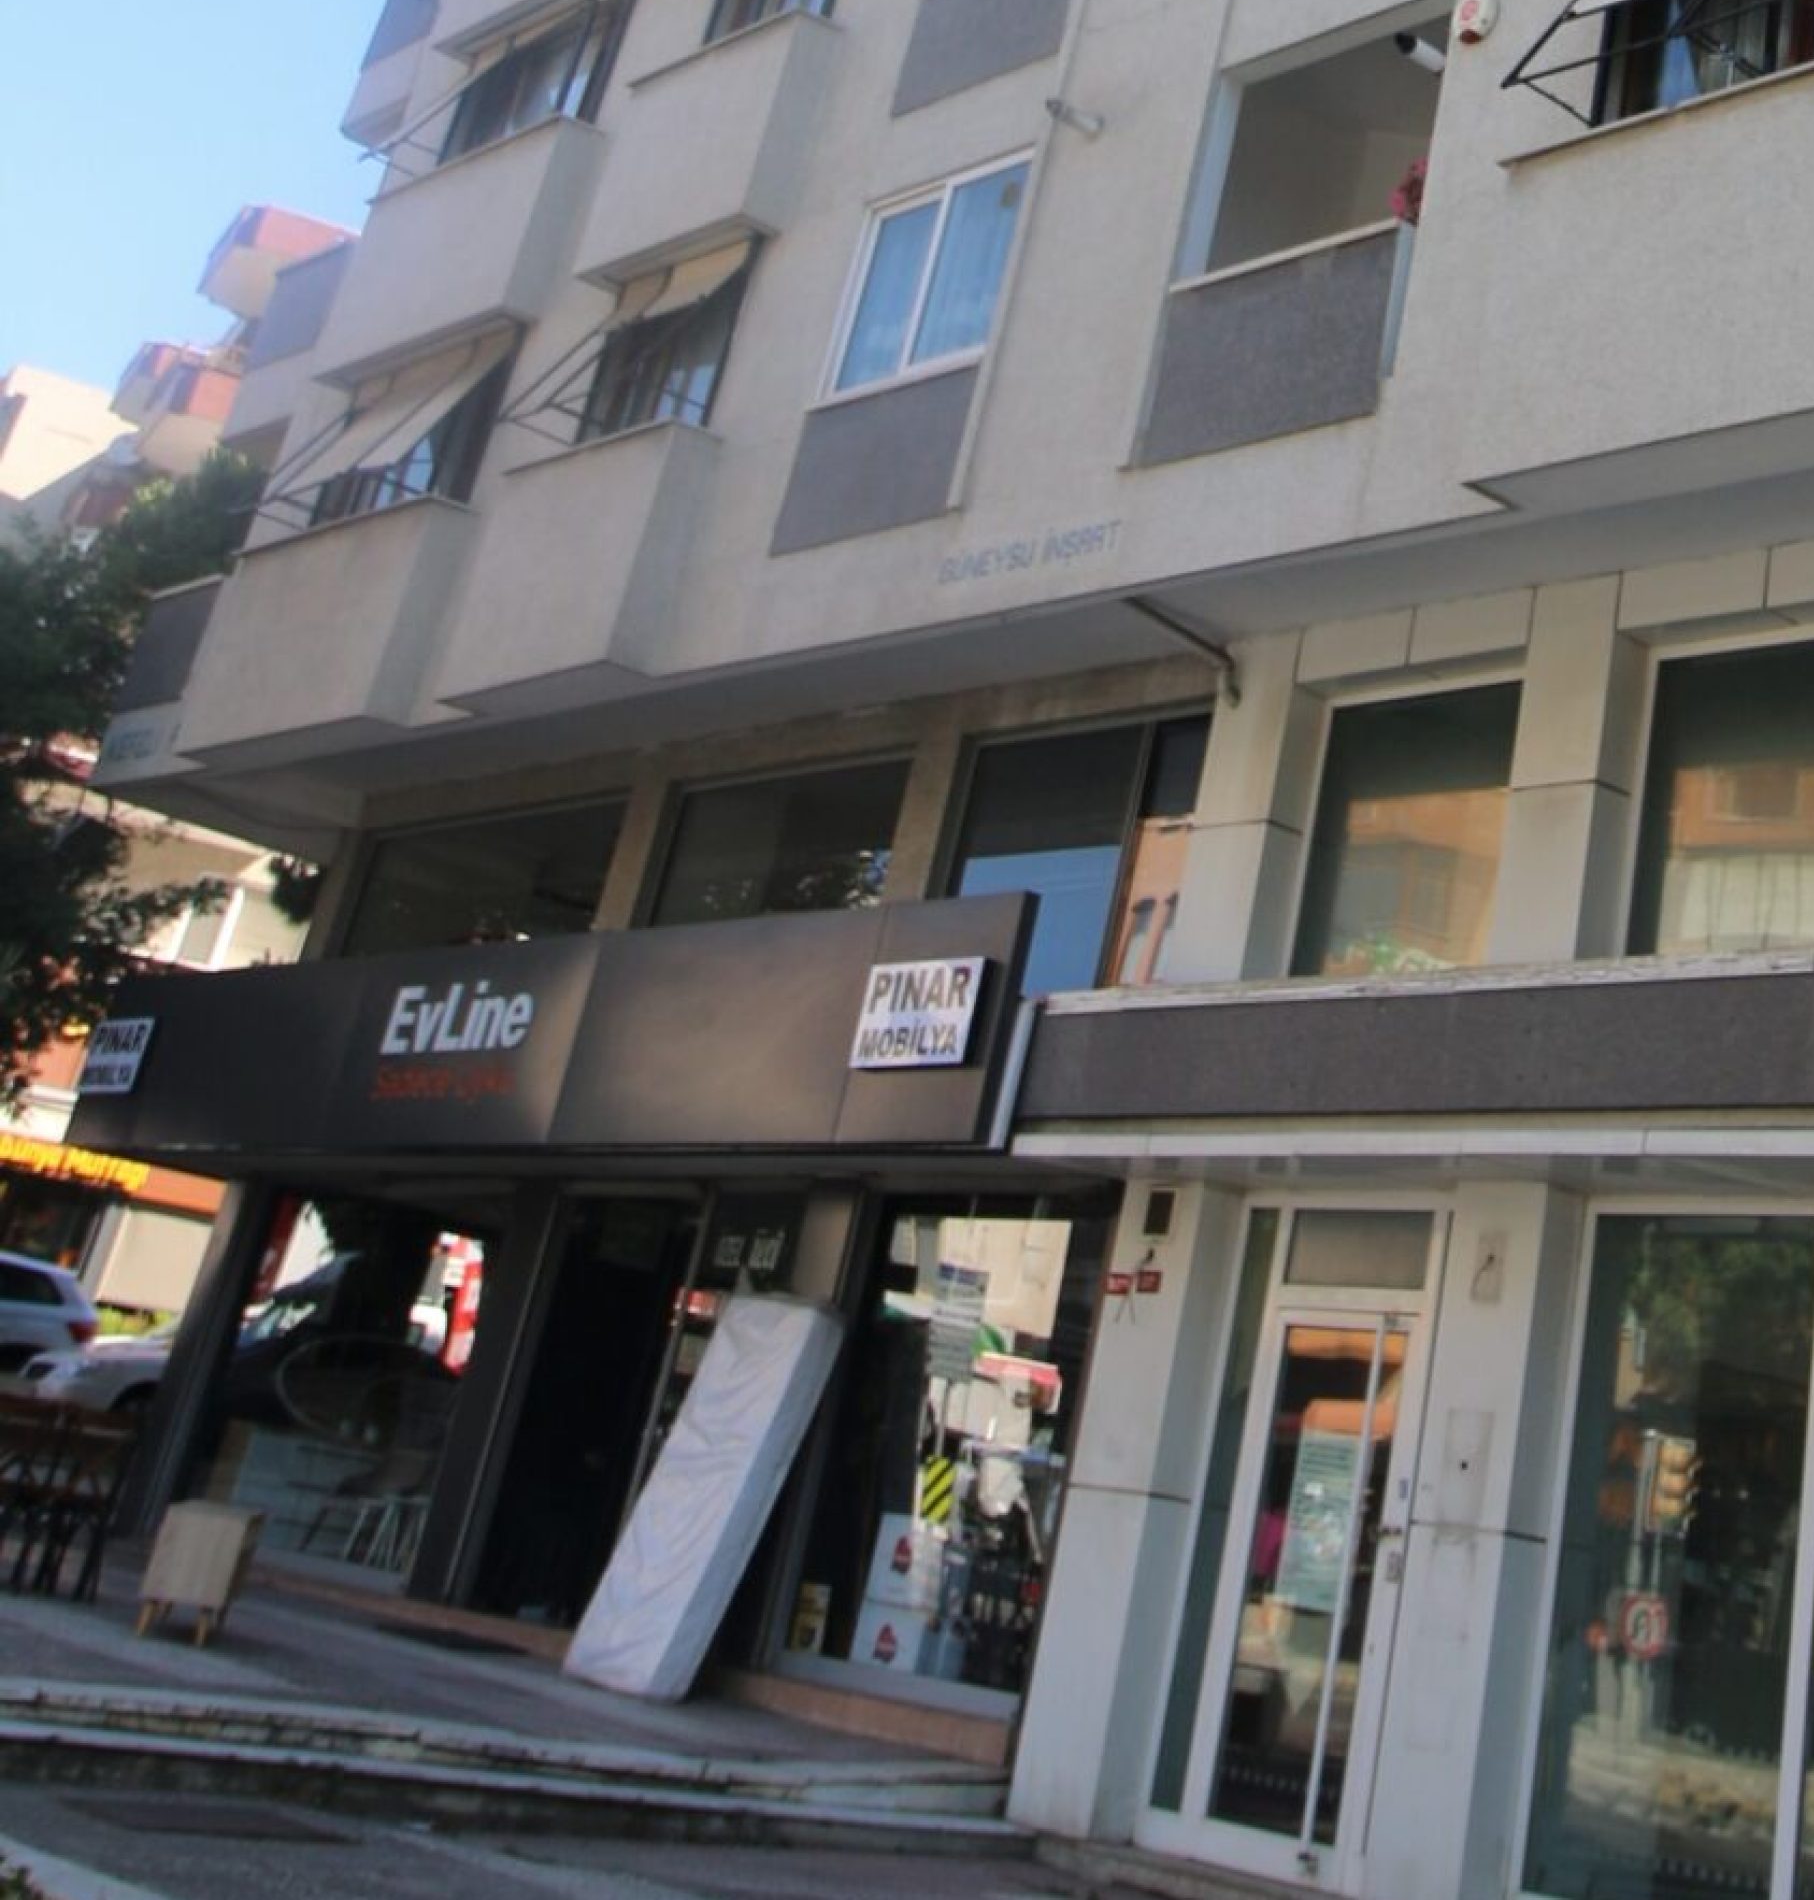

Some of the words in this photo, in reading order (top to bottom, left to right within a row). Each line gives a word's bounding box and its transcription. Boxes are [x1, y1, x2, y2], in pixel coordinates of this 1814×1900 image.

[868, 966, 971, 1014] PINAR
[379, 980, 534, 1055] EvLine
[858, 1019, 957, 1058] MOBİLYA
